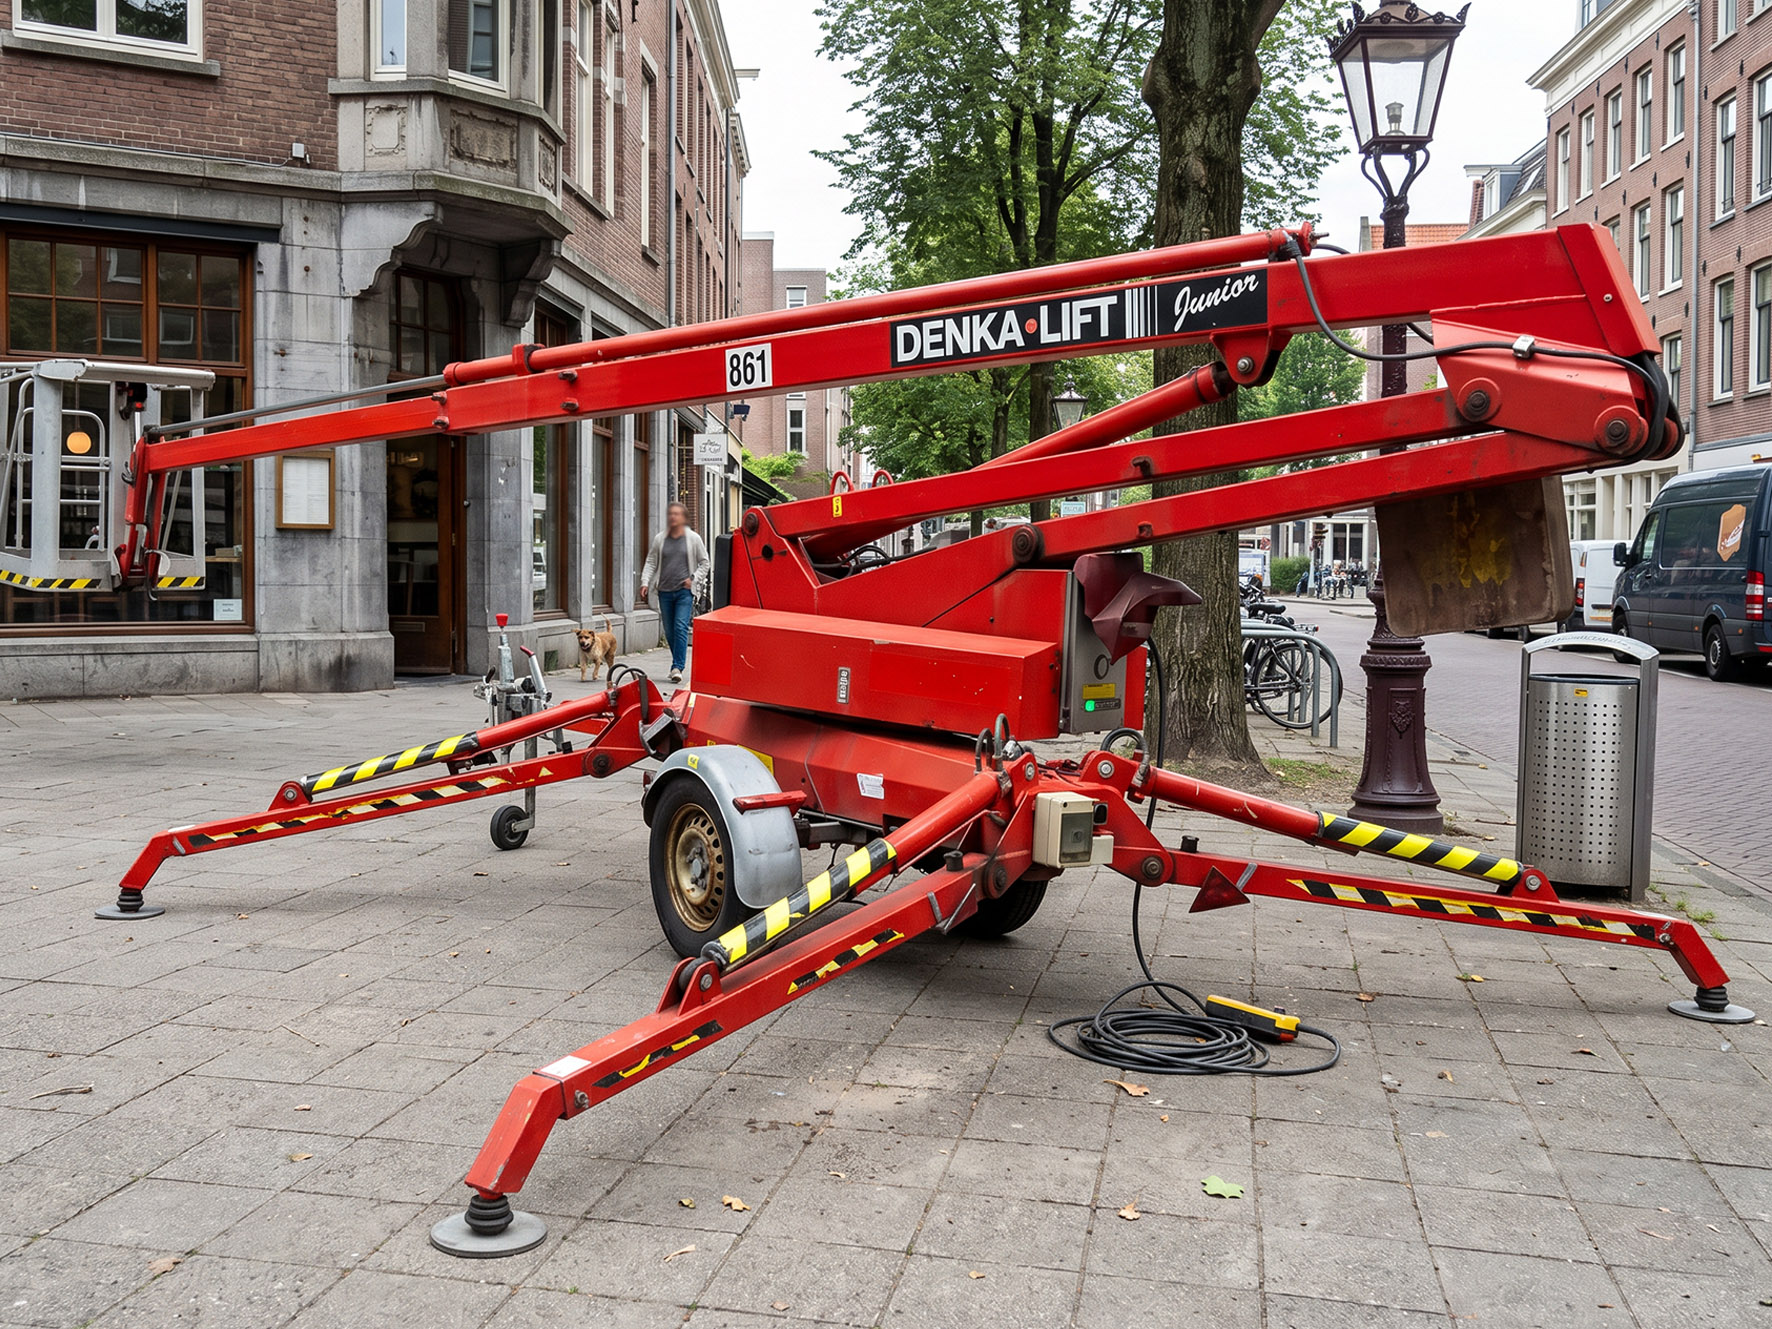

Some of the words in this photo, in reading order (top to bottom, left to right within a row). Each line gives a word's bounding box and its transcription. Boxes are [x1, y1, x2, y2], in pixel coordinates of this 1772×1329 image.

[895, 309, 1025, 363] DENKA
[1039, 295, 1118, 344] LIFT
[1173, 273, 1259, 332] Junior
[729, 349, 766, 387] 861
